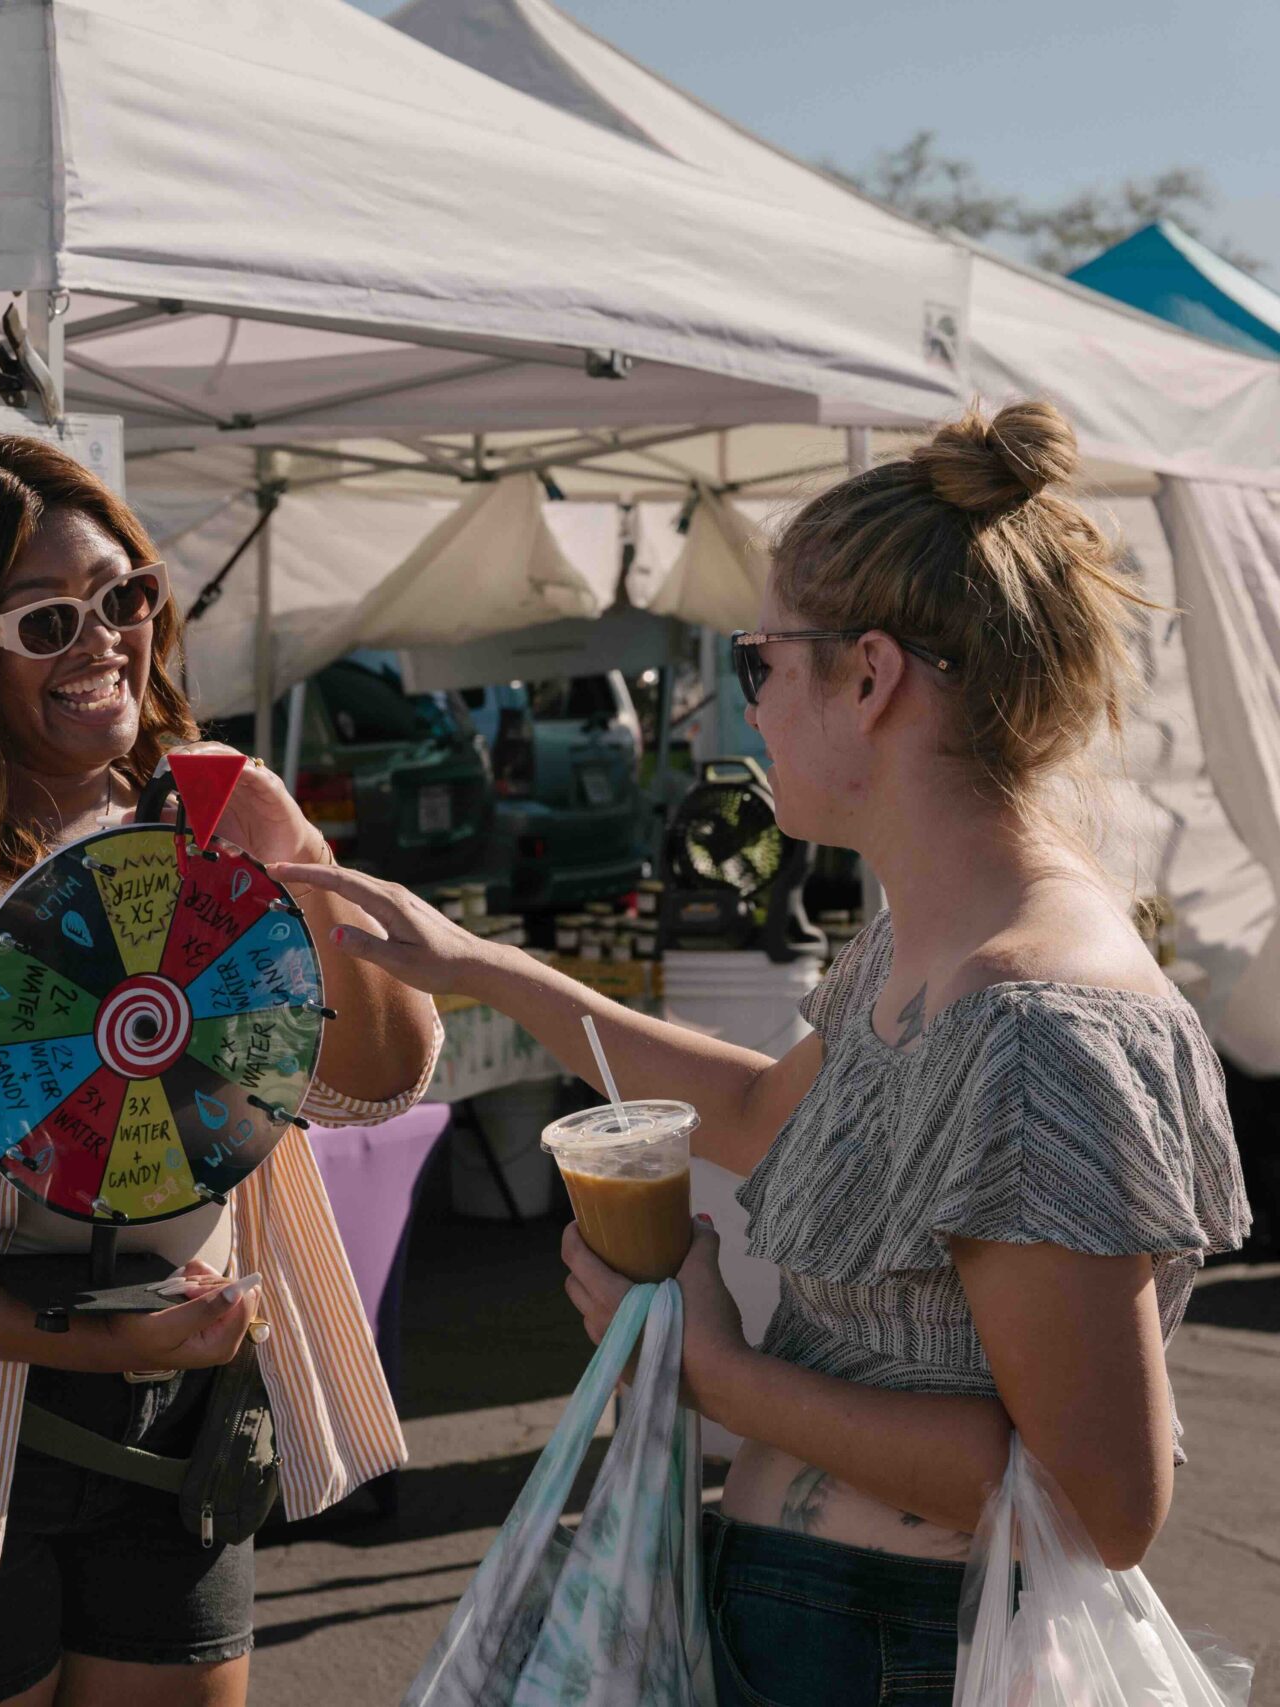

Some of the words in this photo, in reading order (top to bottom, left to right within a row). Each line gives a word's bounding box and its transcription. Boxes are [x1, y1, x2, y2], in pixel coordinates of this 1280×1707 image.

[35, 875, 82, 920] WILD
[109, 873, 170, 906] WATER
[184, 880, 239, 937] WATER
[11, 964, 48, 1032] WATER
[217, 957, 250, 1011] WATER
[248, 947, 289, 1006] CANDY
[30, 1042, 62, 1101] WATER
[240, 1022, 276, 1088] WATER
[54, 1108, 107, 1159] WATER
[120, 1120, 171, 1144] WATER
[205, 1118, 254, 1168] WILD
[109, 1161, 161, 1188] CANDY
